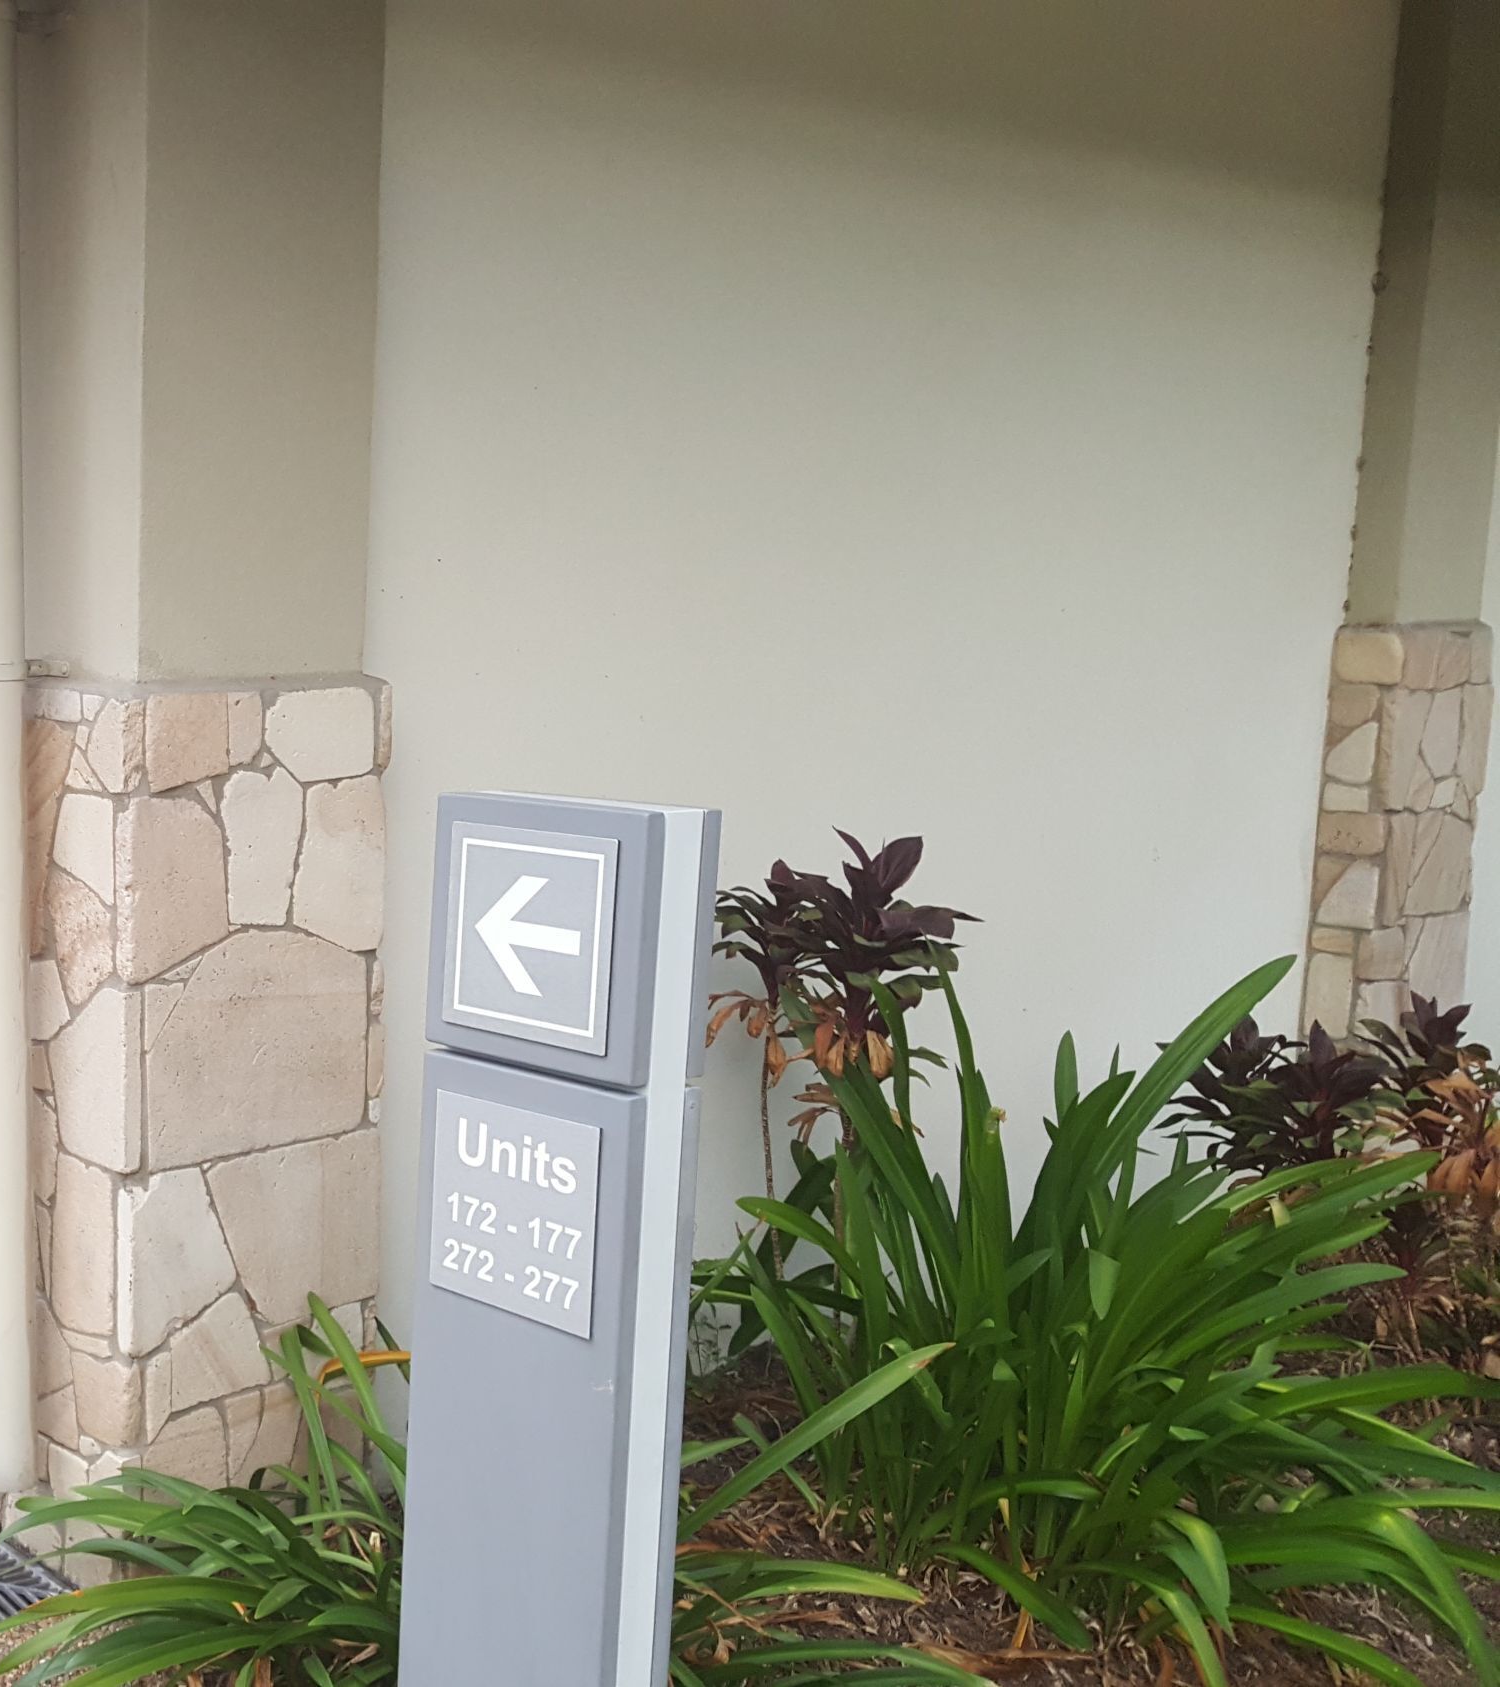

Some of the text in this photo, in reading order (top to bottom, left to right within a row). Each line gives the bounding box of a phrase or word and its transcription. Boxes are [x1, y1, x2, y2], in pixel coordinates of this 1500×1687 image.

[457, 1117, 577, 1194] Units
[447, 1191, 582, 1260] 172 - 177
[442, 1238, 579, 1310] 272 - 277
